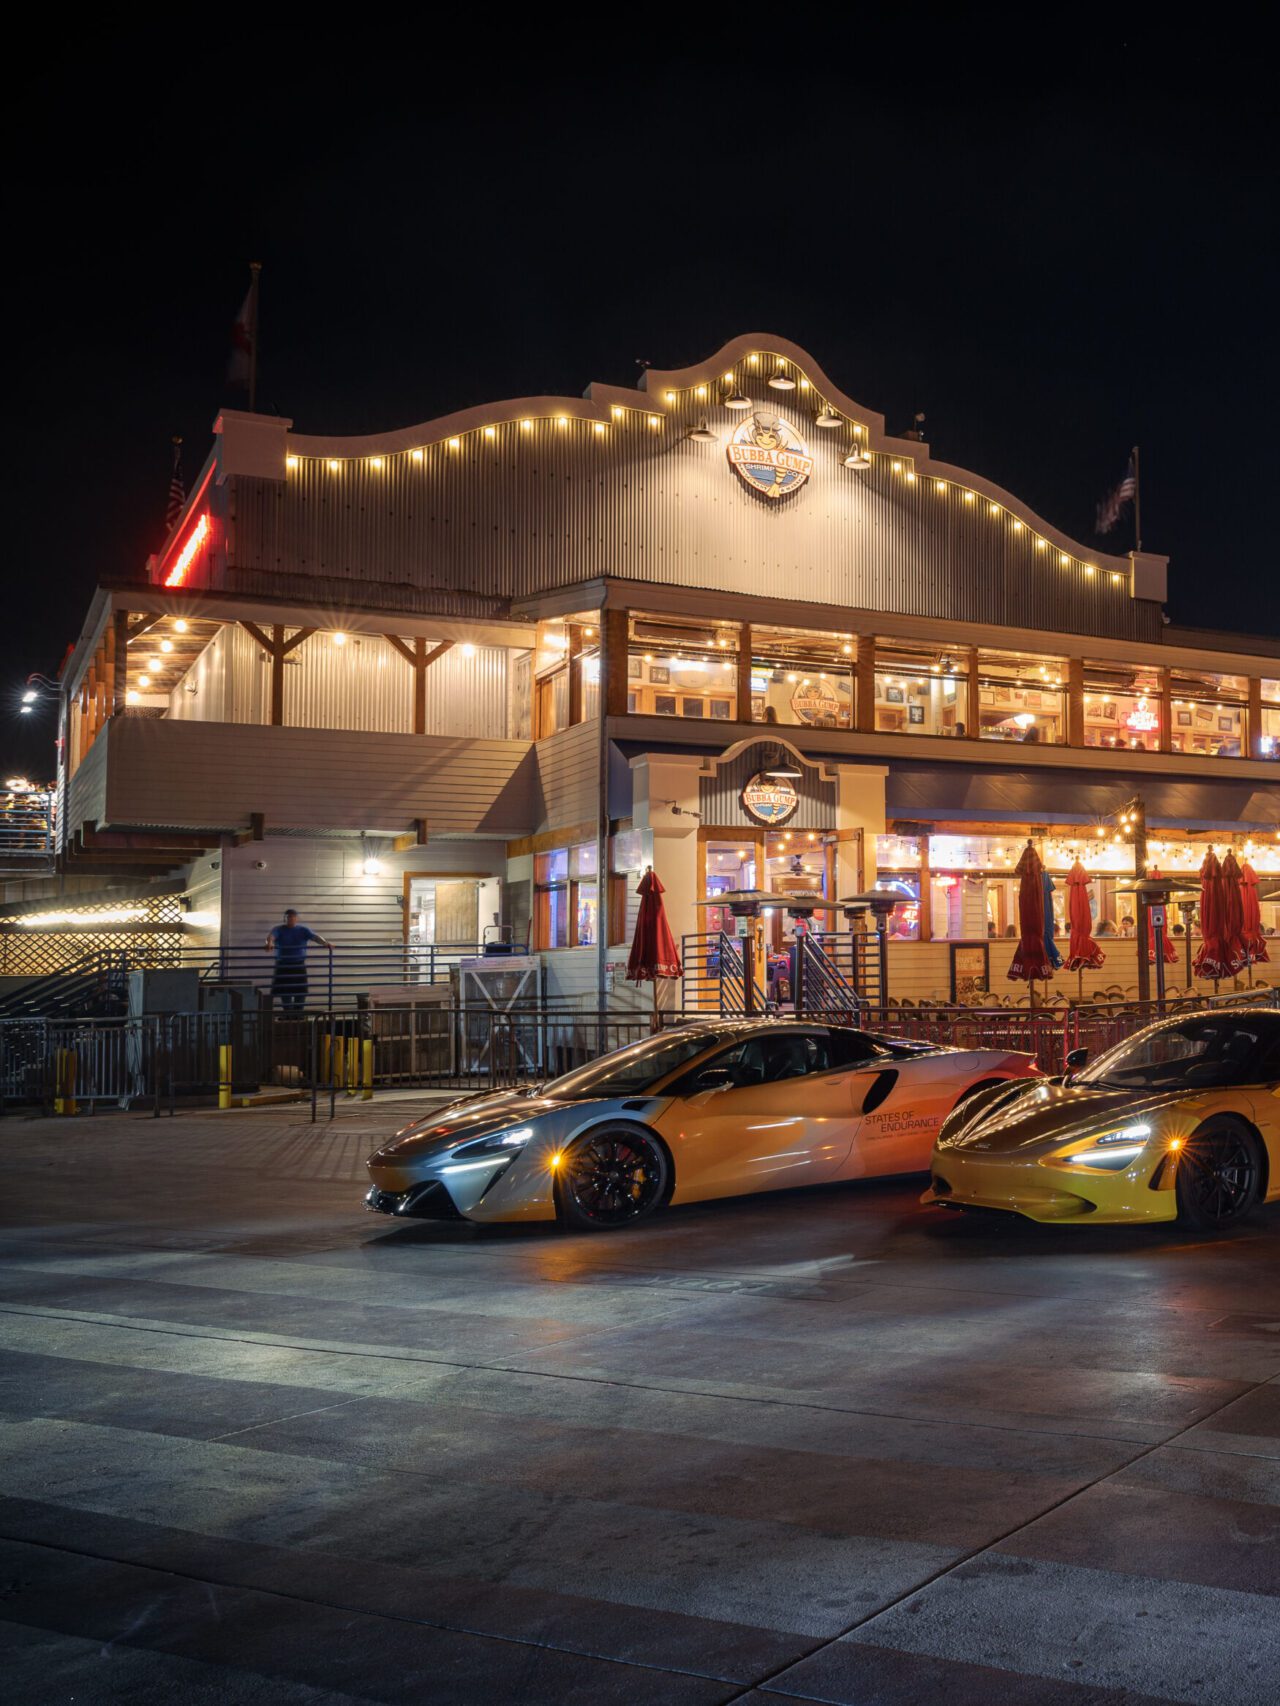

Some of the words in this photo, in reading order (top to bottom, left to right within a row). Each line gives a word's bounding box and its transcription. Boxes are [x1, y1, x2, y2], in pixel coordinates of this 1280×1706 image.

[732, 446, 773, 463] BUBBA
[777, 451, 809, 471] GUMP
[746, 794, 771, 803] BUBBA
[774, 794, 796, 805] GUMP
[865, 1113, 899, 1125] STATES
[901, 1111, 914, 1121] OF
[881, 1117, 939, 1133] ENDURANCE
